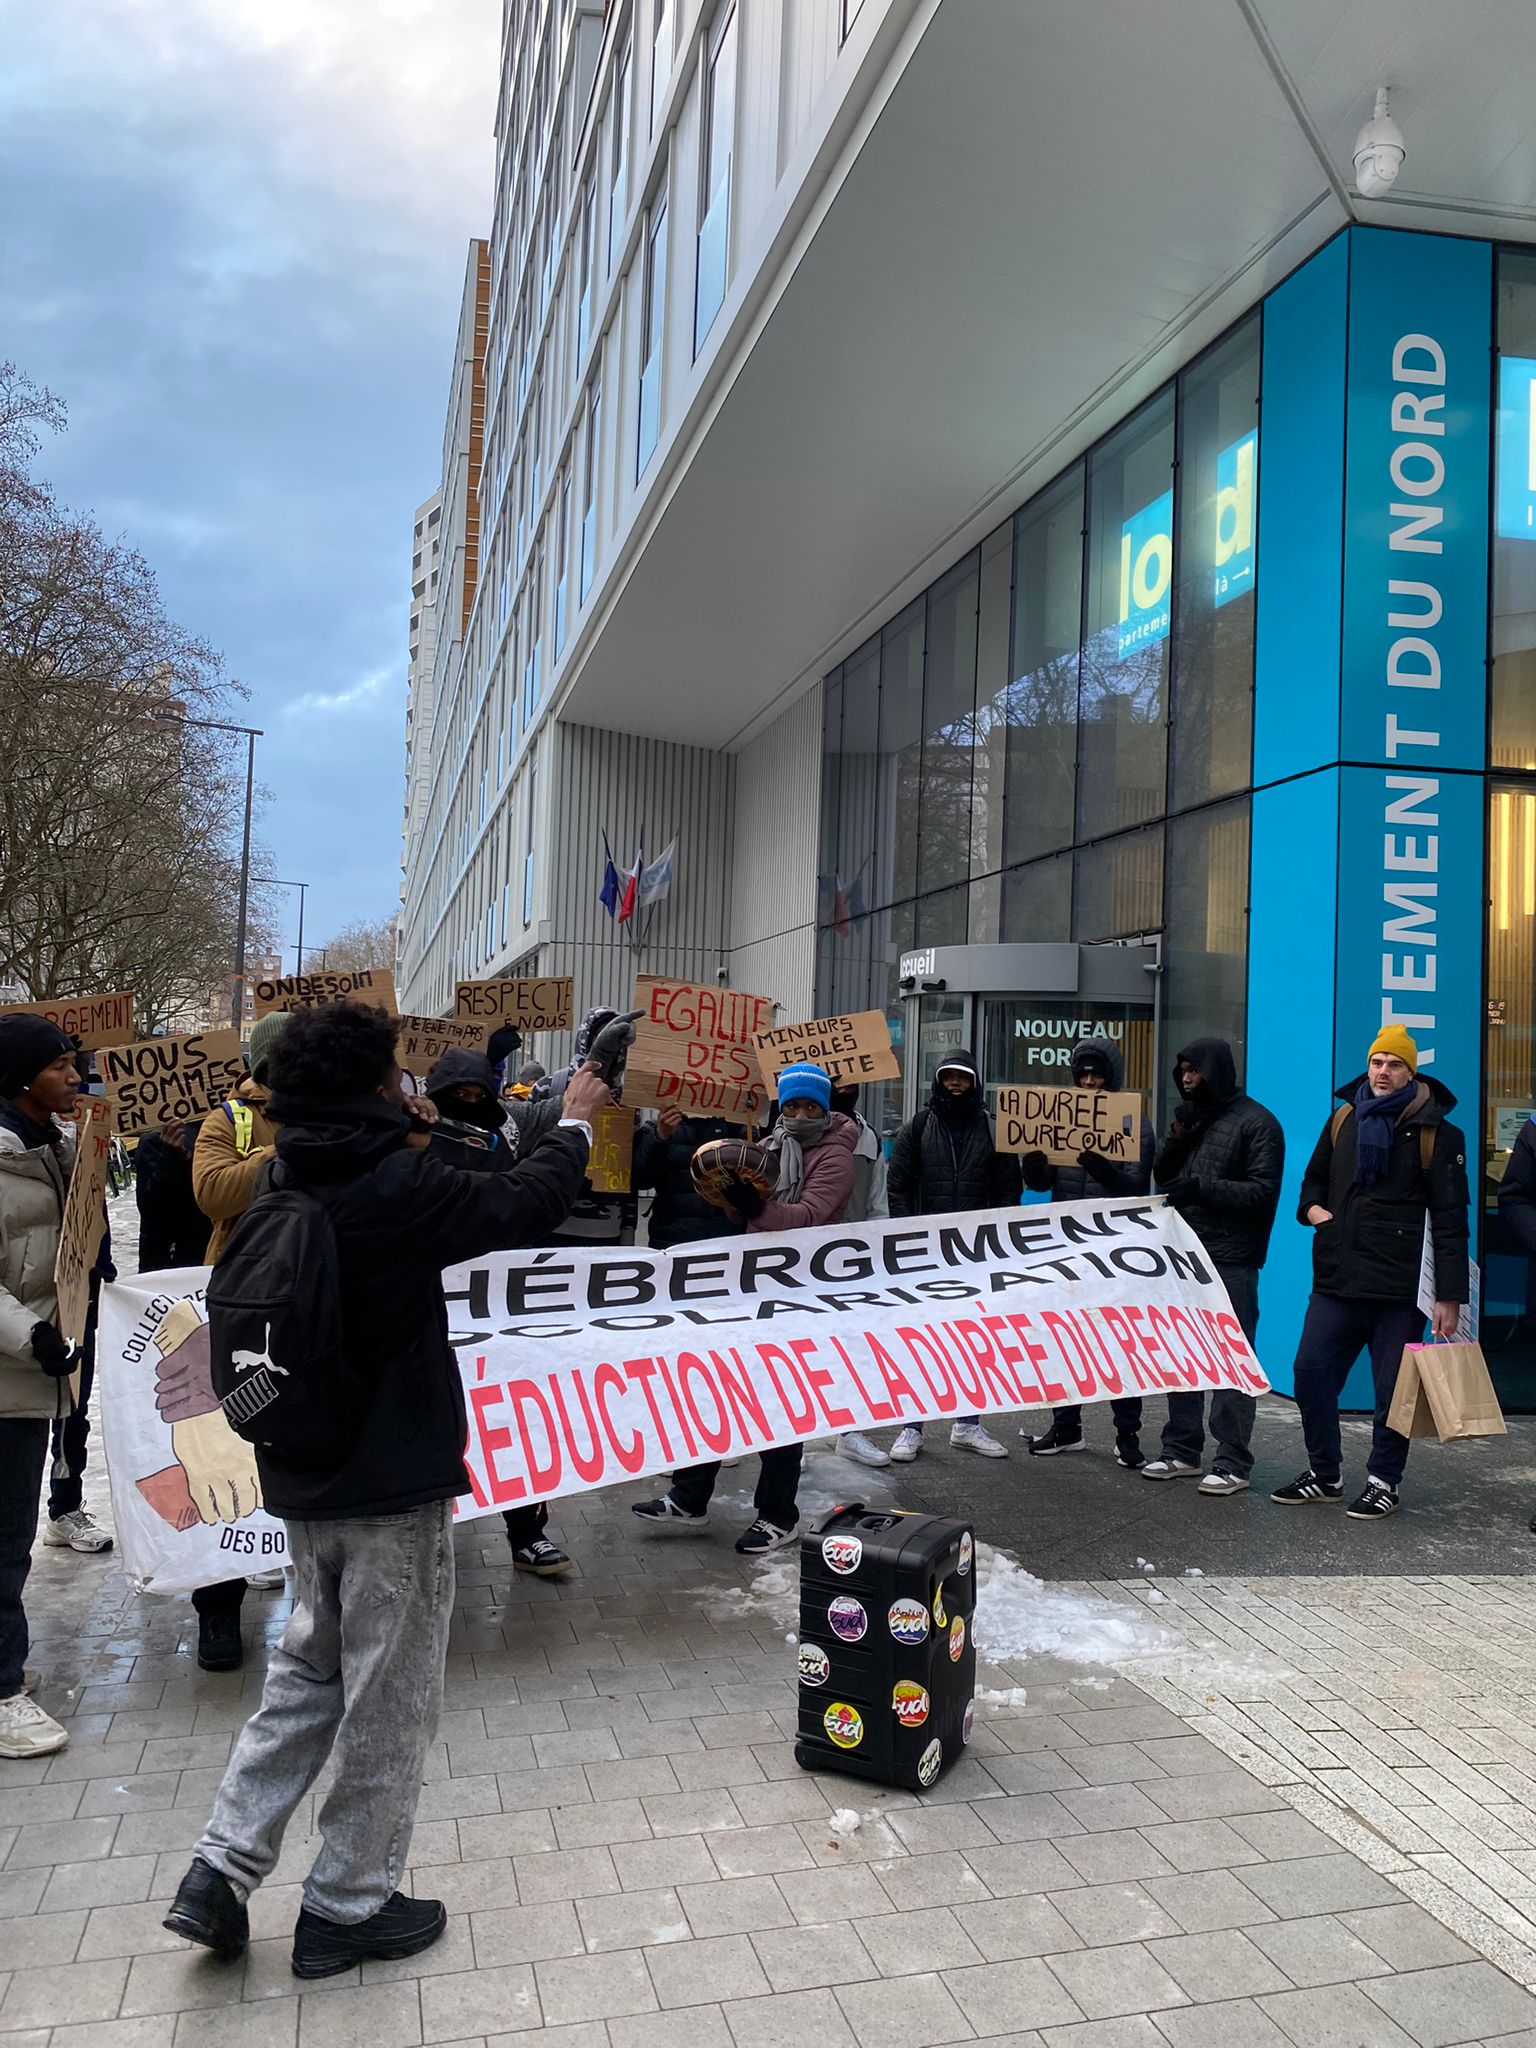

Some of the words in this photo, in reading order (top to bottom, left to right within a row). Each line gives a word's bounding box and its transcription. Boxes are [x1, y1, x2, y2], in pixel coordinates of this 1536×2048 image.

[1389, 333, 1447, 555] NORD
[1387, 579, 1444, 690] DU
[1382, 713, 1441, 1067] TEMENT
[900, 949, 936, 977] ccueil
[518, 1013, 567, 1029] NOUS
[757, 1018, 853, 1049] MINEURS
[1015, 1019, 1124, 1040] NOUVEAU
[687, 1041, 751, 1081] DES
[1027, 1047, 1074, 1066] FOR
[656, 1069, 766, 1113] DROITS
[1000, 1090, 1020, 1115] LA
[117, 1107, 147, 1133] EN
[443, 1206, 1158, 1320] HÉBERGEMENT
[220, 1367, 280, 1424] UMA
[453, 1346, 775, 1515] ÉDUCTION
[754, 1337, 857, 1436] DE
[829, 1330, 929, 1422] LA
[895, 1300, 1068, 1412] DURÉE
[1040, 1308, 1122, 1398] DU
[219, 1526, 256, 1554] DES
